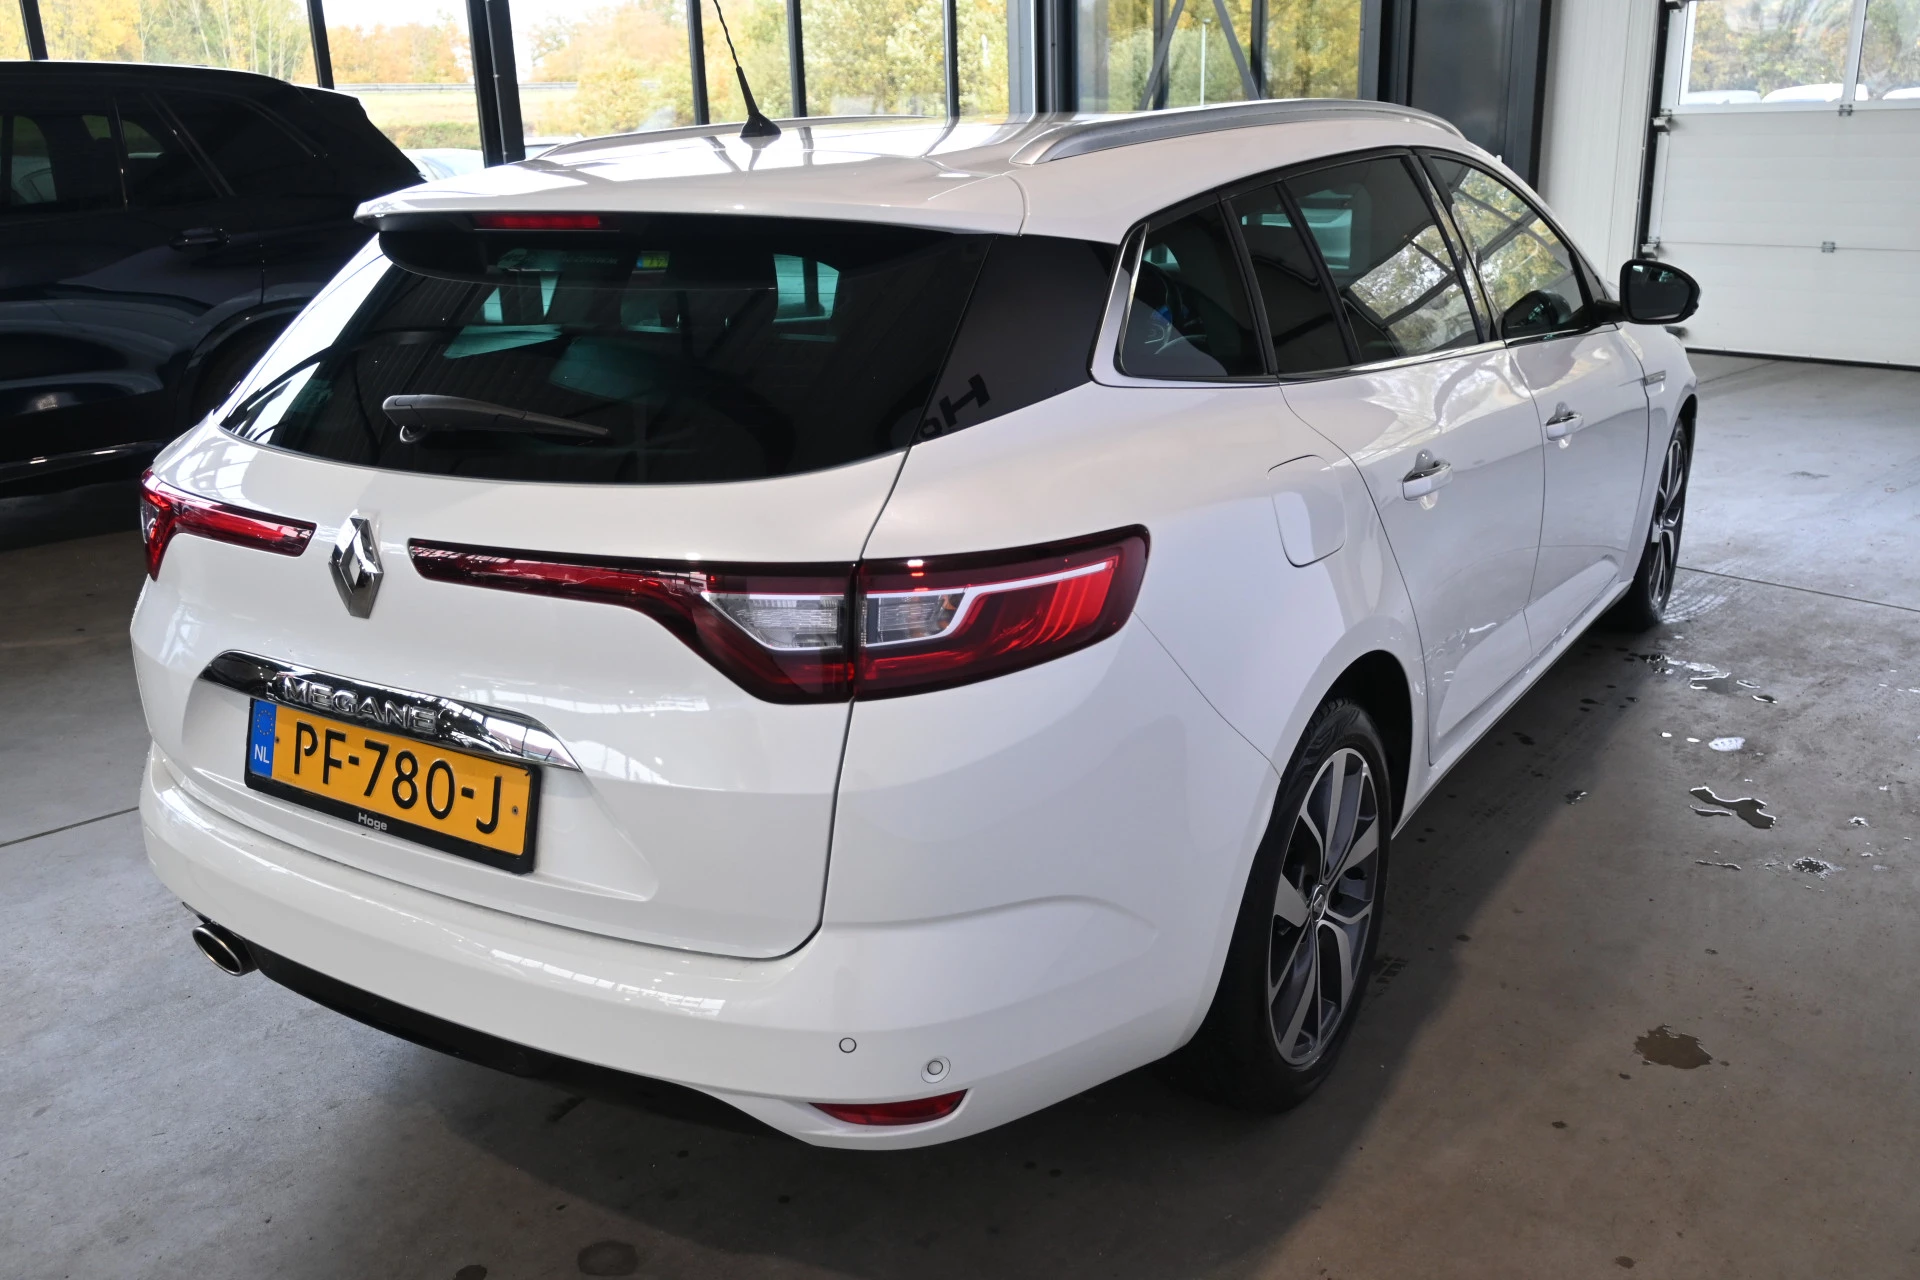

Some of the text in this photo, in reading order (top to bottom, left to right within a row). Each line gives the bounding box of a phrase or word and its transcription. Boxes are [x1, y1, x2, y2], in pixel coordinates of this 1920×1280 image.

[284, 676, 436, 735] MEGANE
[254, 743, 270, 764] NL
[293, 721, 502, 835] PF-780-J
[358, 811, 388, 831] Hoge
